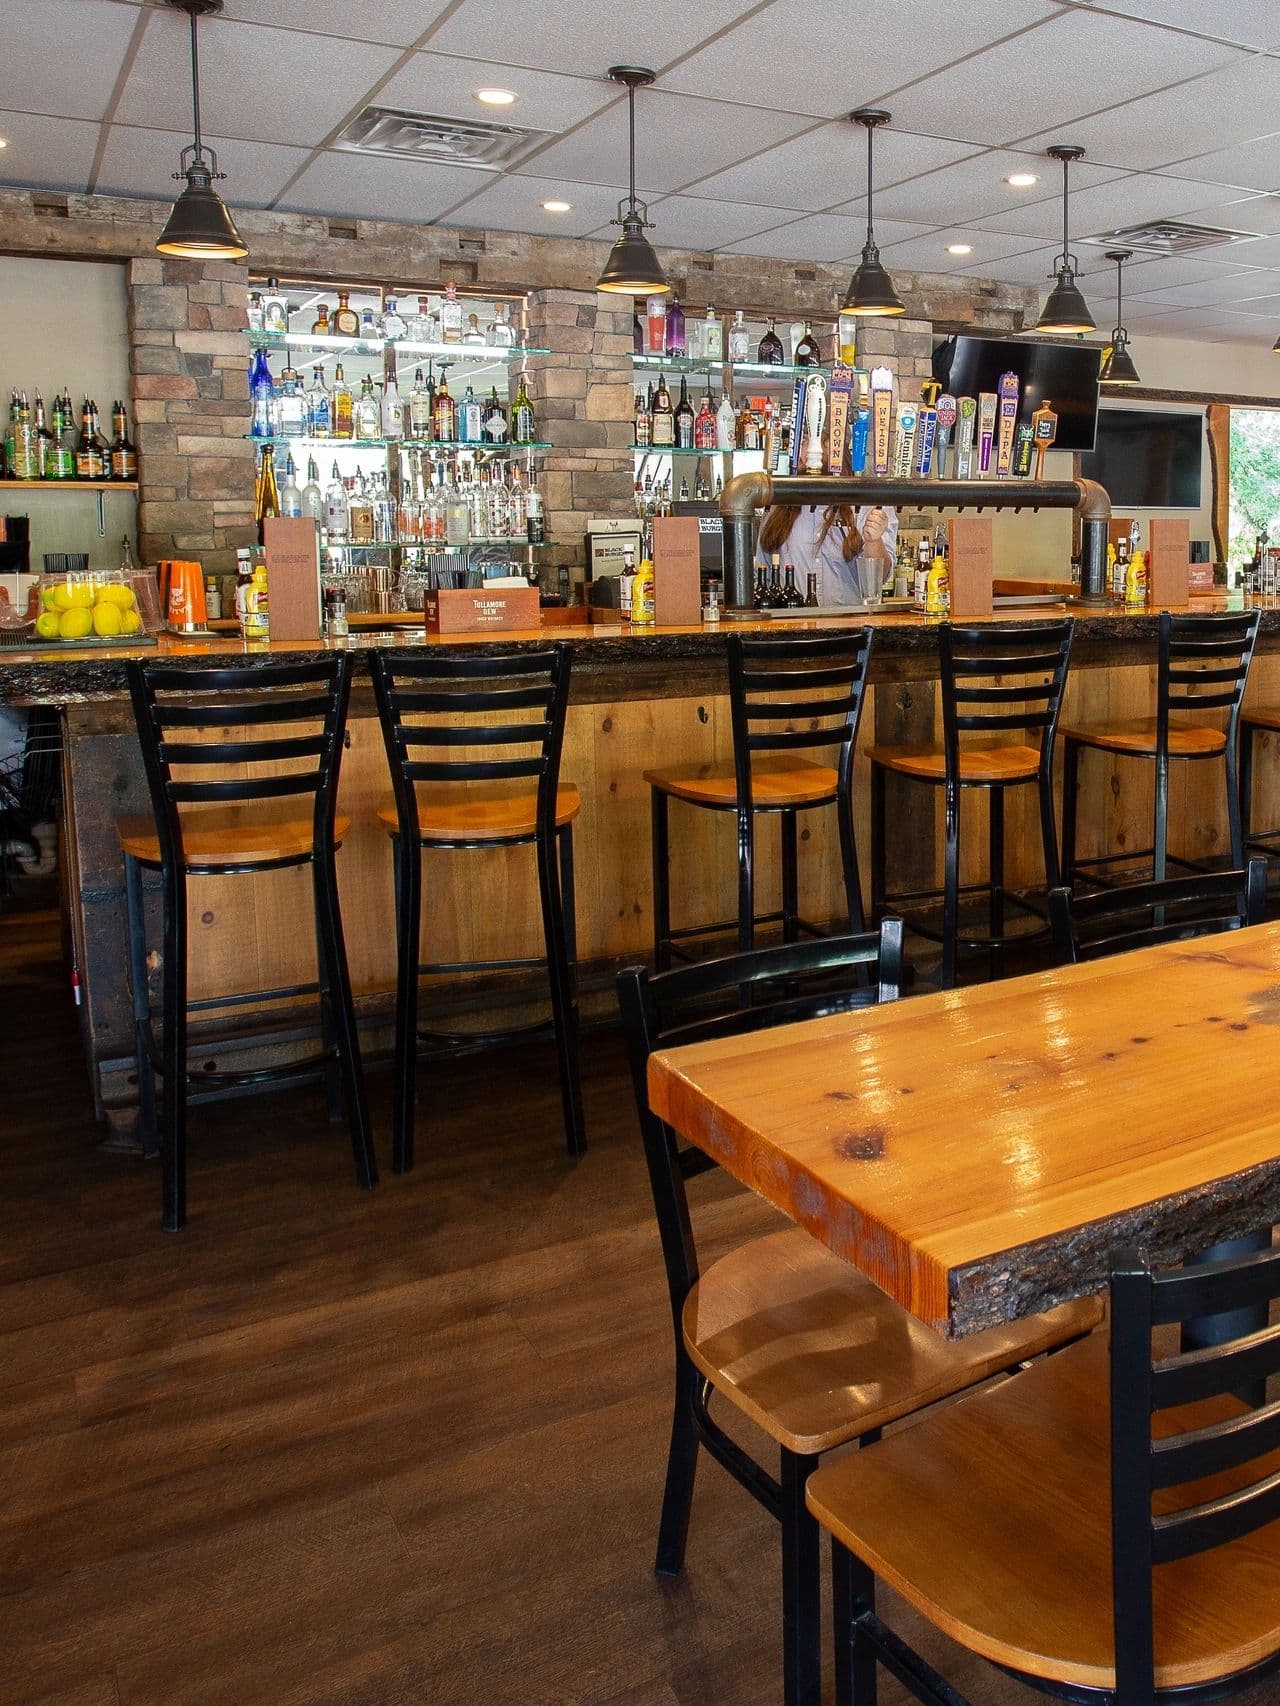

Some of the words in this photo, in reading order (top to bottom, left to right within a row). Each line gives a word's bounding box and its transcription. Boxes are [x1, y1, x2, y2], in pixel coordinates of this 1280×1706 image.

[833, 408, 843, 458] BROWN
[879, 407, 888, 457] WEISS
[1001, 420, 1011, 460] DIPA
[960, 461, 968, 475] IPA
[473, 600, 507, 609] TULLAMORE
